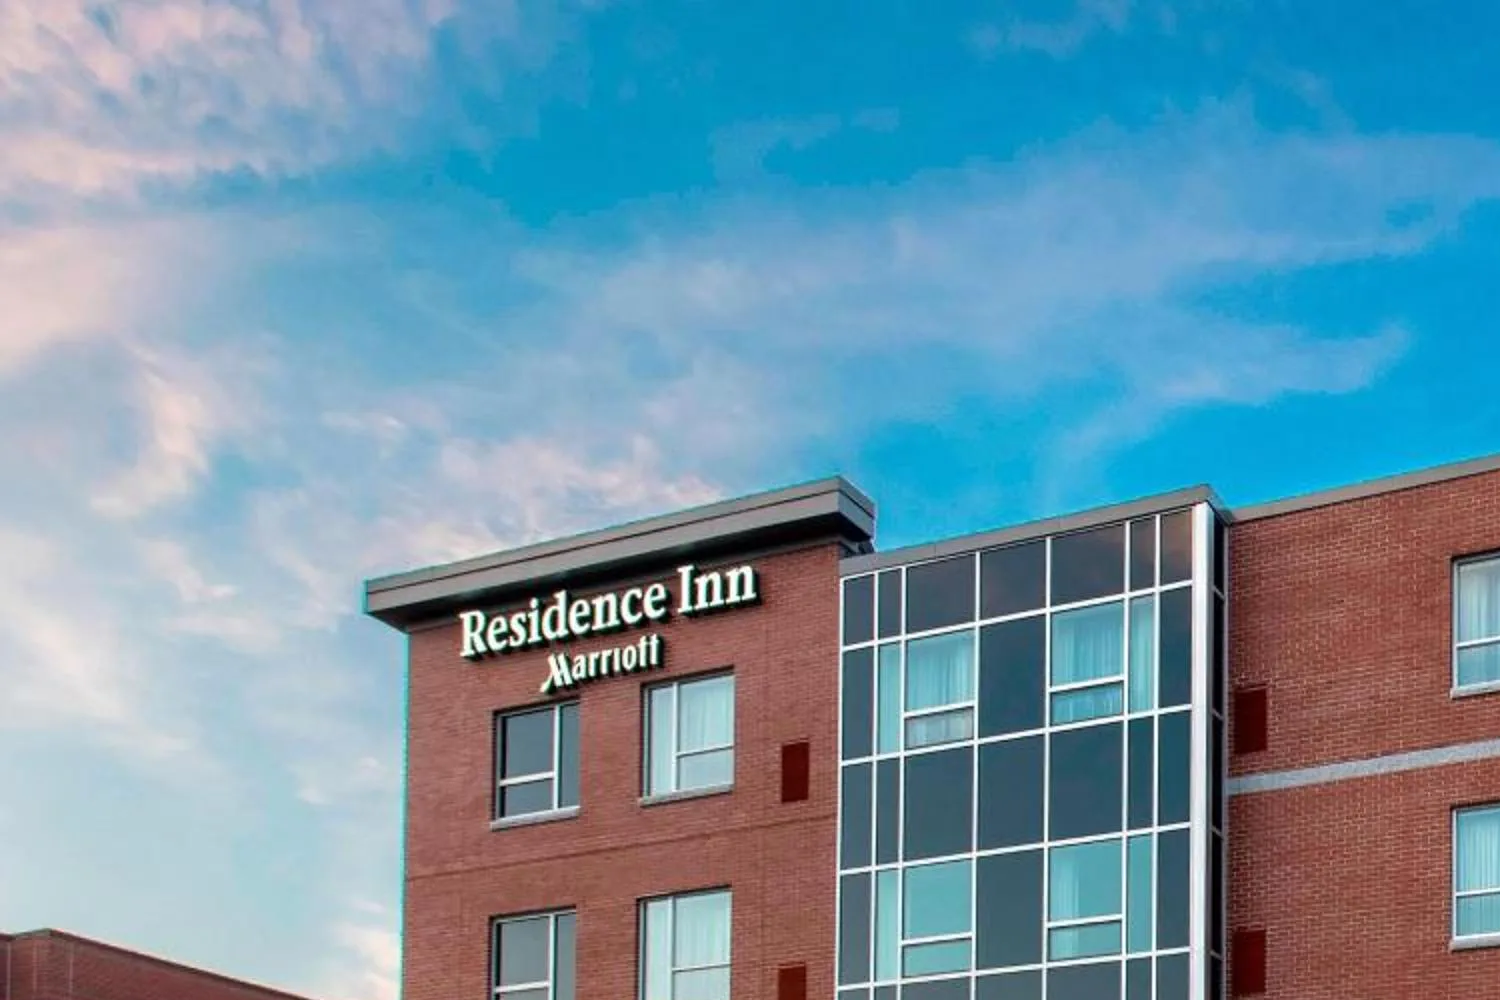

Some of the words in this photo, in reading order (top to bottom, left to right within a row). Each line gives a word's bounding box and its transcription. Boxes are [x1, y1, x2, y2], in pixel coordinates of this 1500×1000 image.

[459, 589, 667, 657] Residence
[676, 564, 757, 615] Inn
[539, 633, 662, 693] Marriott
